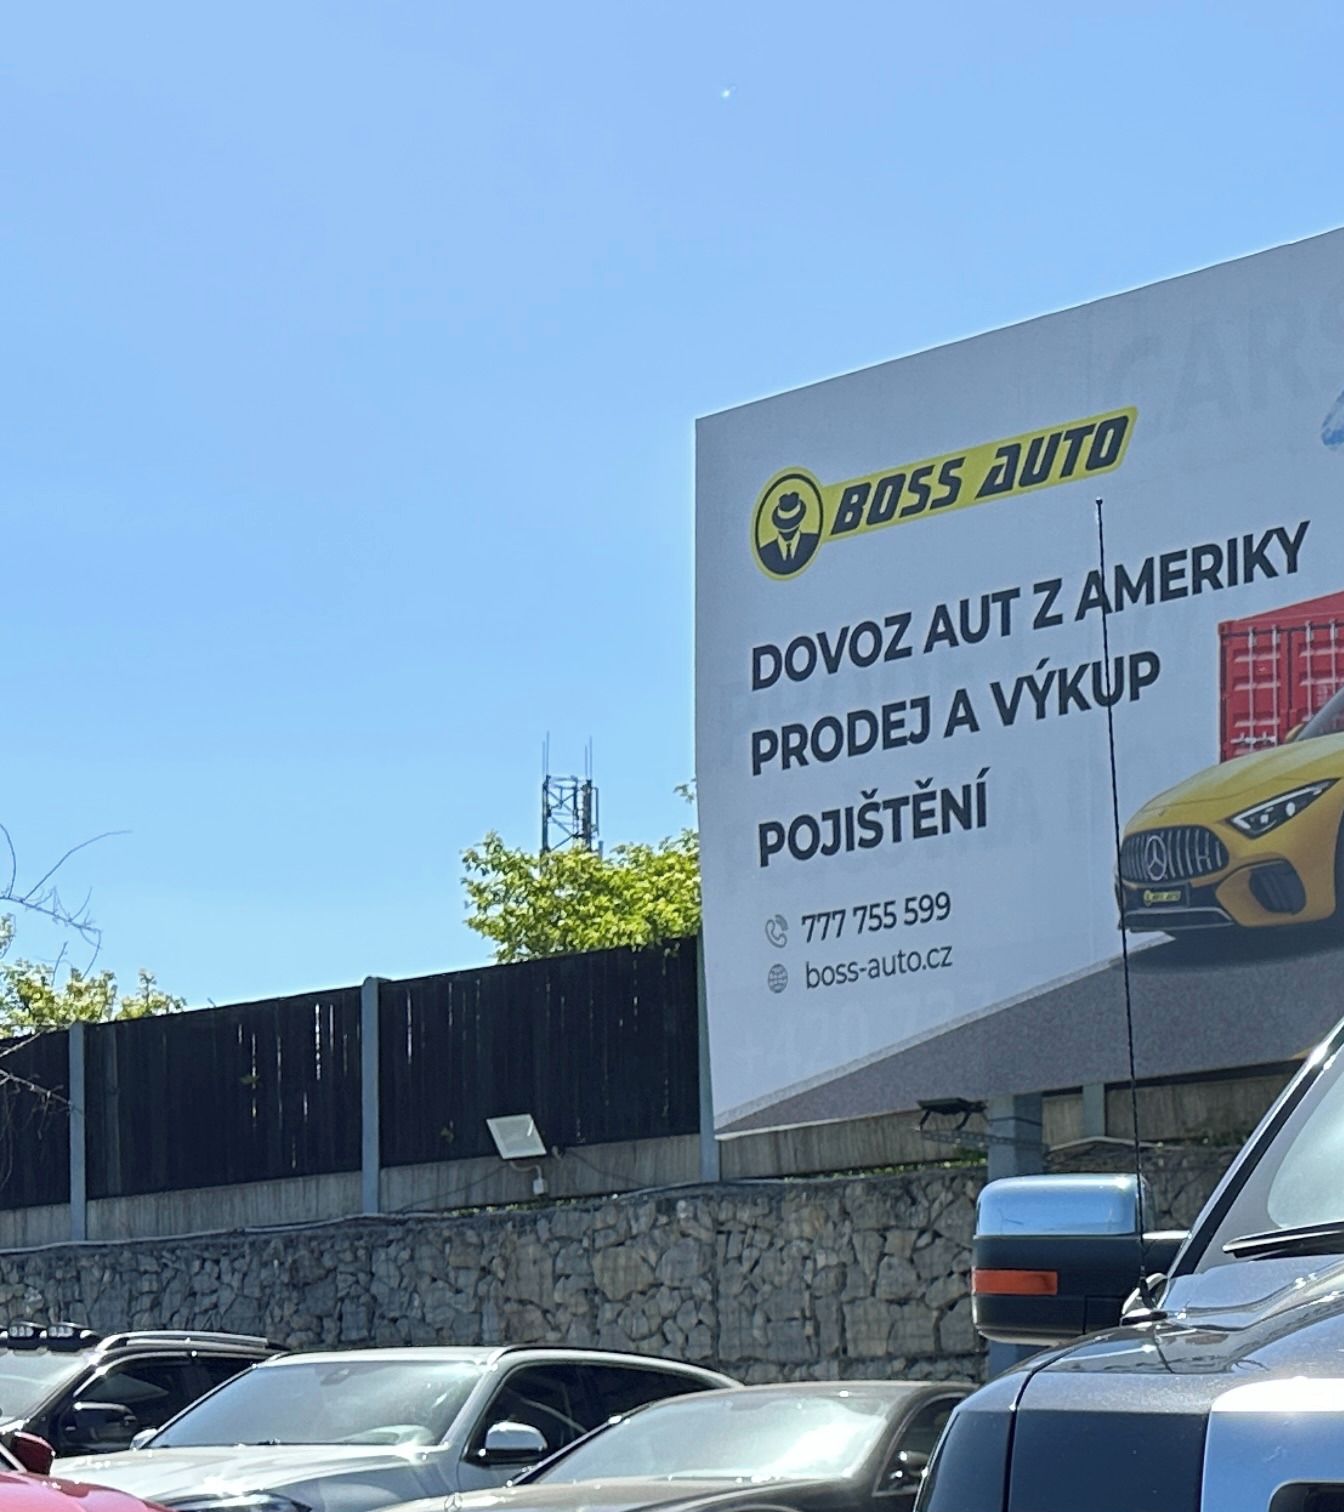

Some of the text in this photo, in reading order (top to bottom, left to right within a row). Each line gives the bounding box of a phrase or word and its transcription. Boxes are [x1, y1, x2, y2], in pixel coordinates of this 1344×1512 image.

[831, 415, 1129, 535] BOSS AUTO
[752, 520, 1311, 691] DOVOZ AUT Z AMERIKY
[752, 651, 1161, 775] PRODEJ A VÝKUP
[759, 767, 992, 867] POJIŠTĚNÍ
[801, 891, 951, 943] 777 755 599
[806, 946, 953, 989] boss-auto.cz
